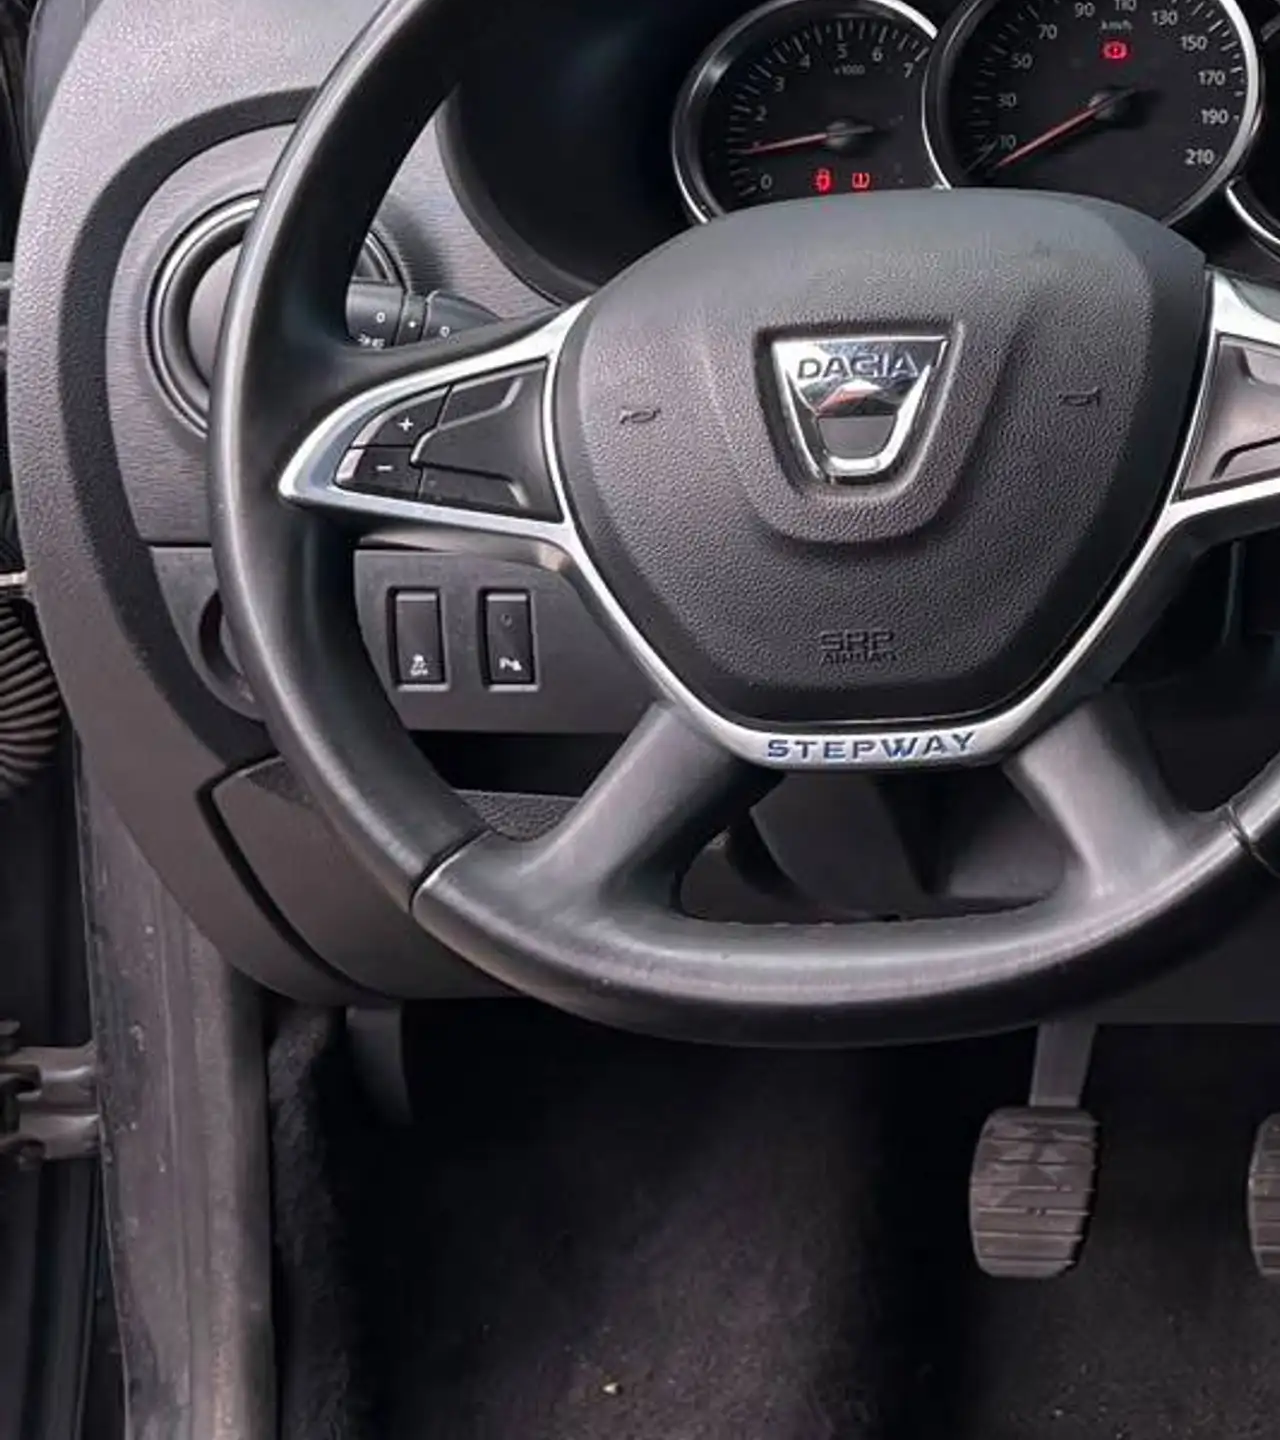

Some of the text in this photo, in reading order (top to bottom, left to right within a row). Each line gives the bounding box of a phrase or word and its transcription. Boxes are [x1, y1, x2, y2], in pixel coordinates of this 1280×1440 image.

[1074, 2, 1096, 18] 90
[1151, 10, 1178, 26] 130
[1038, 25, 1058, 40] 70
[1181, 36, 1208, 51] 150
[837, 44, 848, 59] 5
[872, 47, 883, 62] 6
[799, 54, 811, 69] 4
[1011, 54, 1033, 69] 50
[903, 63, 914, 78] 7
[1198, 70, 1226, 85] 170
[774, 77, 785, 92] 3
[997, 92, 1017, 107] 30
[755, 105, 768, 121] 2
[1201, 109, 1228, 125] 190
[1000, 134, 1017, 149] 10
[1184, 149, 1215, 165] 210
[759, 173, 773, 189] 0
[797, 351, 919, 380] DACIA
[820, 629, 895, 652] SRP
[767, 730, 976, 760] STEPWAY
